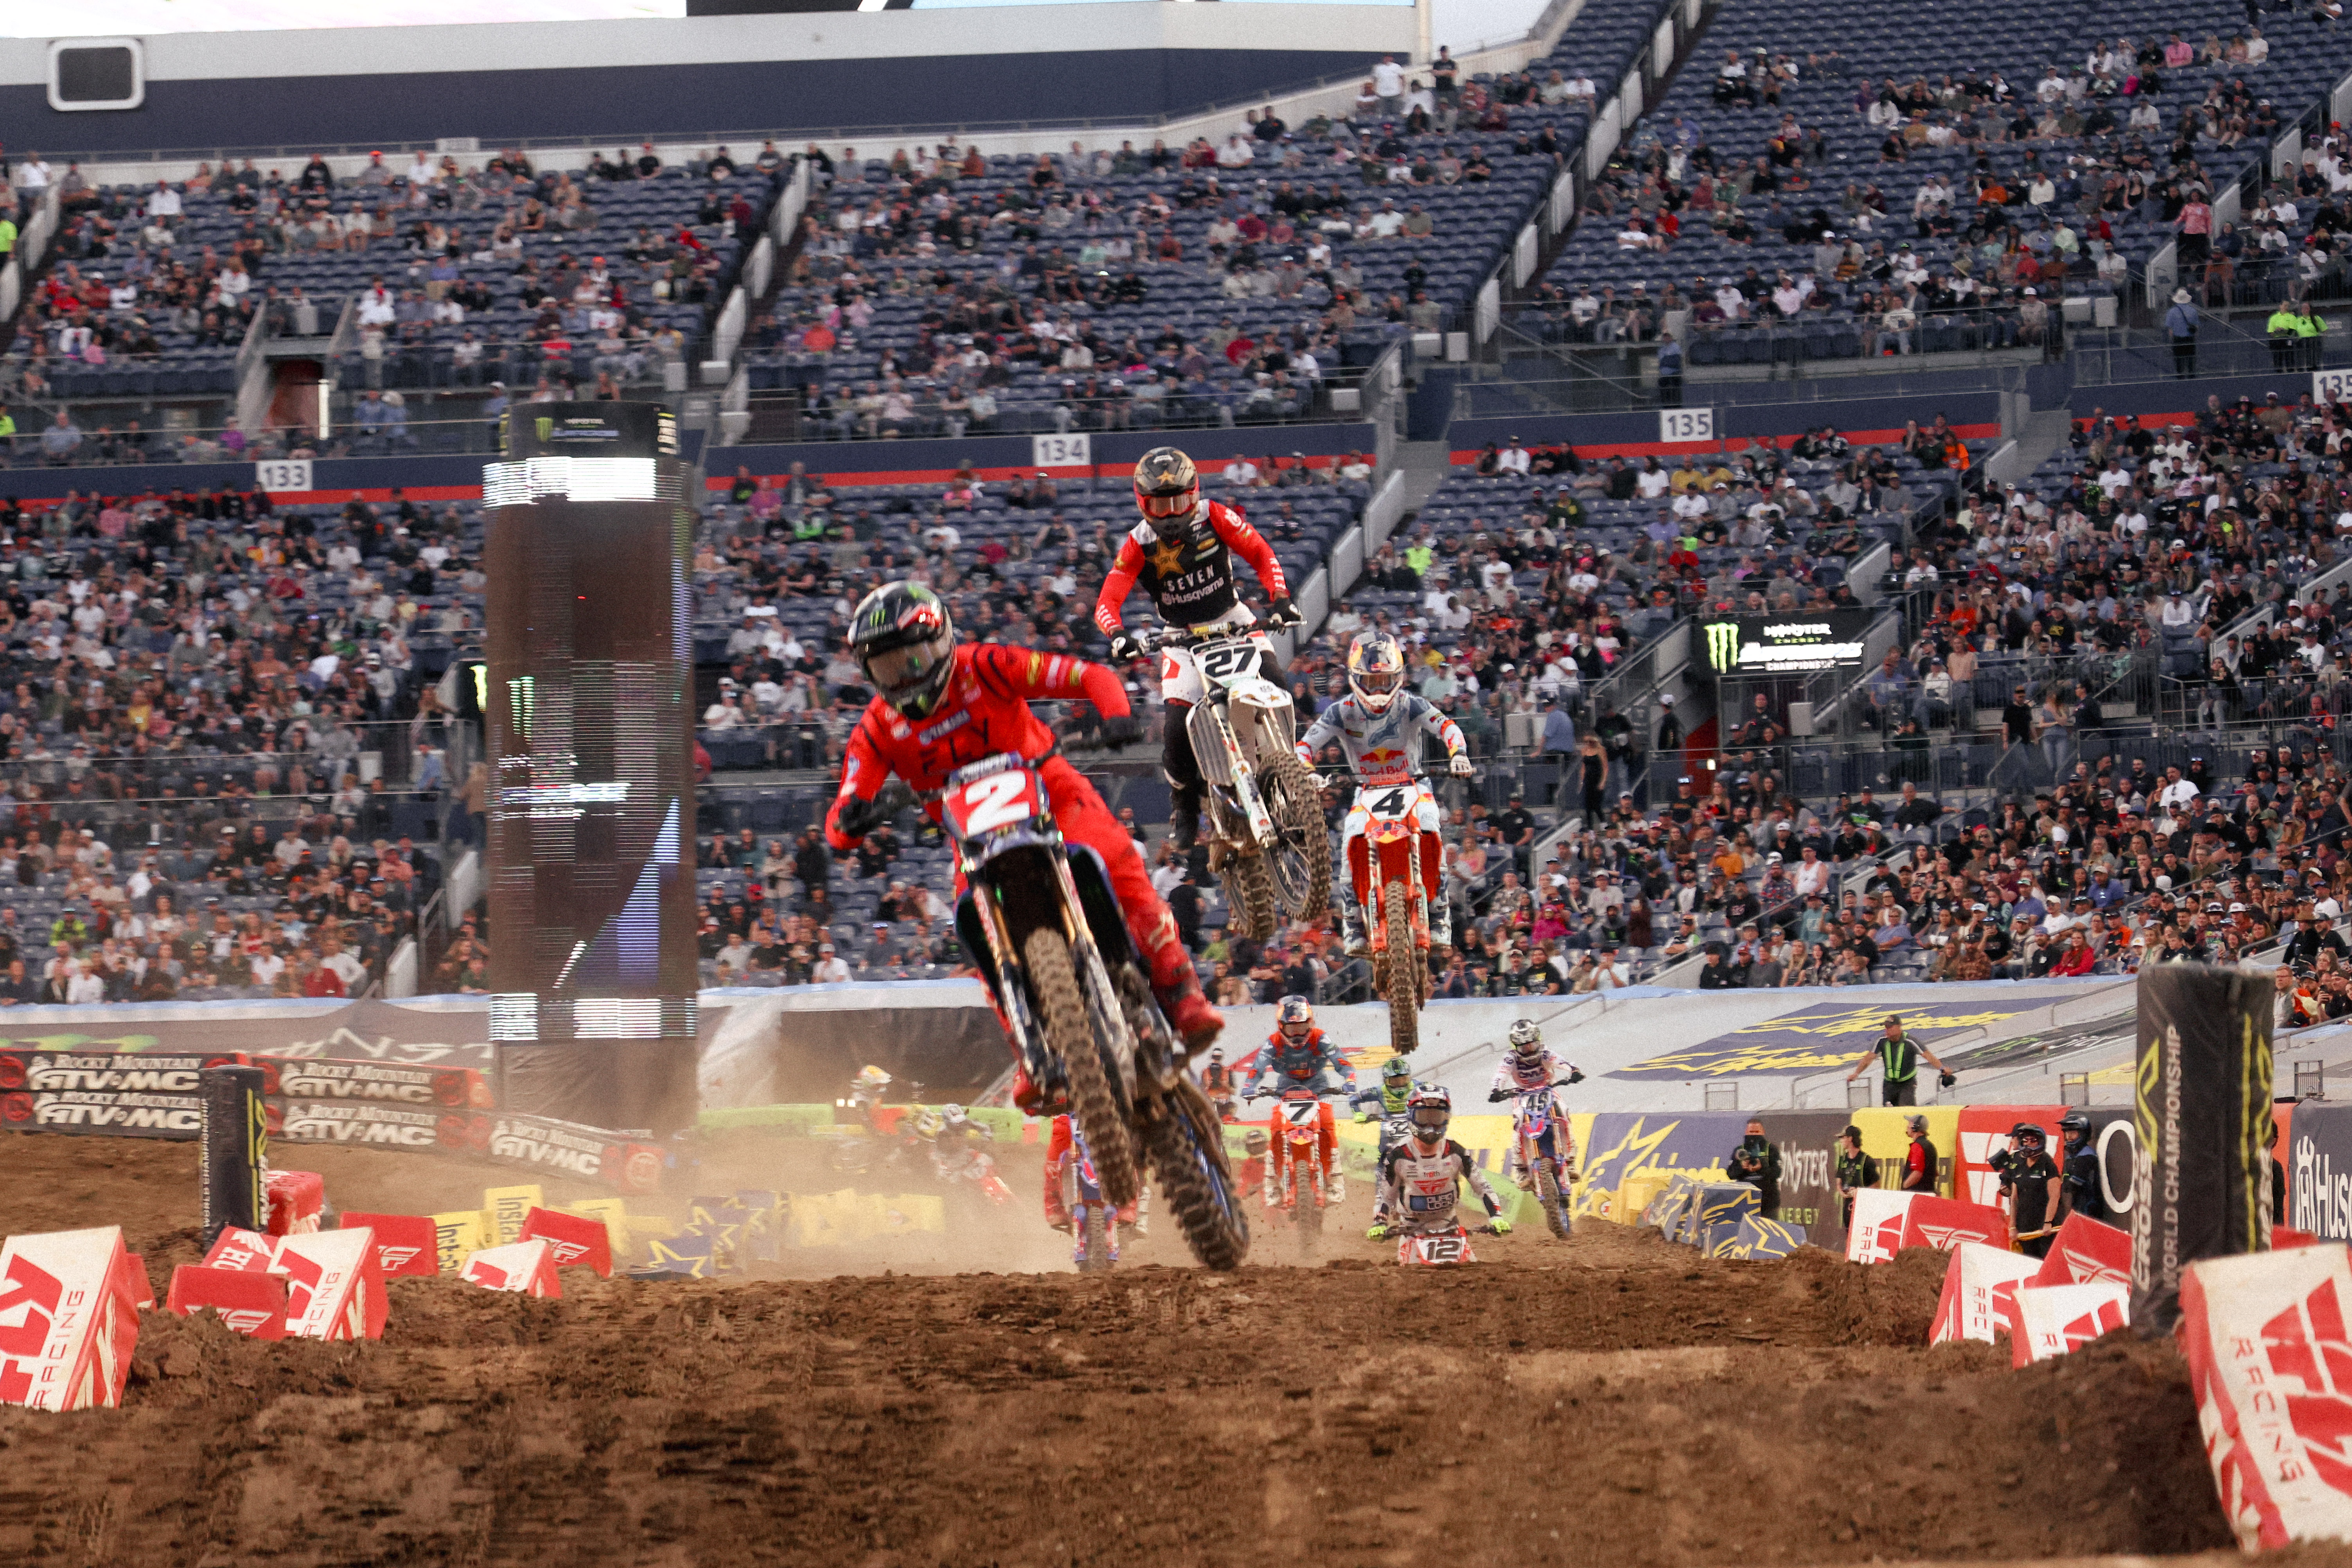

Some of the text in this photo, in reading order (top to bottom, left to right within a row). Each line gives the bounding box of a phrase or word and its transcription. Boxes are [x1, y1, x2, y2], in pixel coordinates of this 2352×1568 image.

[1668, 414, 1710, 436] 135
[1041, 439, 1083, 462] 134
[264, 465, 305, 487] 133
[1167, 564, 1215, 592] SEVEN
[1205, 646, 1256, 678] 27
[965, 770, 1030, 838] 2
[1372, 788, 1405, 816] 4
[53, 1054, 203, 1070] ROCKY MOUNTAIN
[59, 1091, 119, 1105] ROCKY
[1289, 1102, 1315, 1122] 7
[2163, 1024, 2182, 1289] WORLD CHAMPIONSHIP
[2316, 1153, 2352, 1239] Hus
[1779, 1207, 1820, 1225] NERGY
[2138, 1148, 2153, 1291] CROSS
[1427, 1241, 1460, 1260] 12
[32, 1290, 84, 1406] RACING
[2230, 1336, 2305, 1482] RACING
